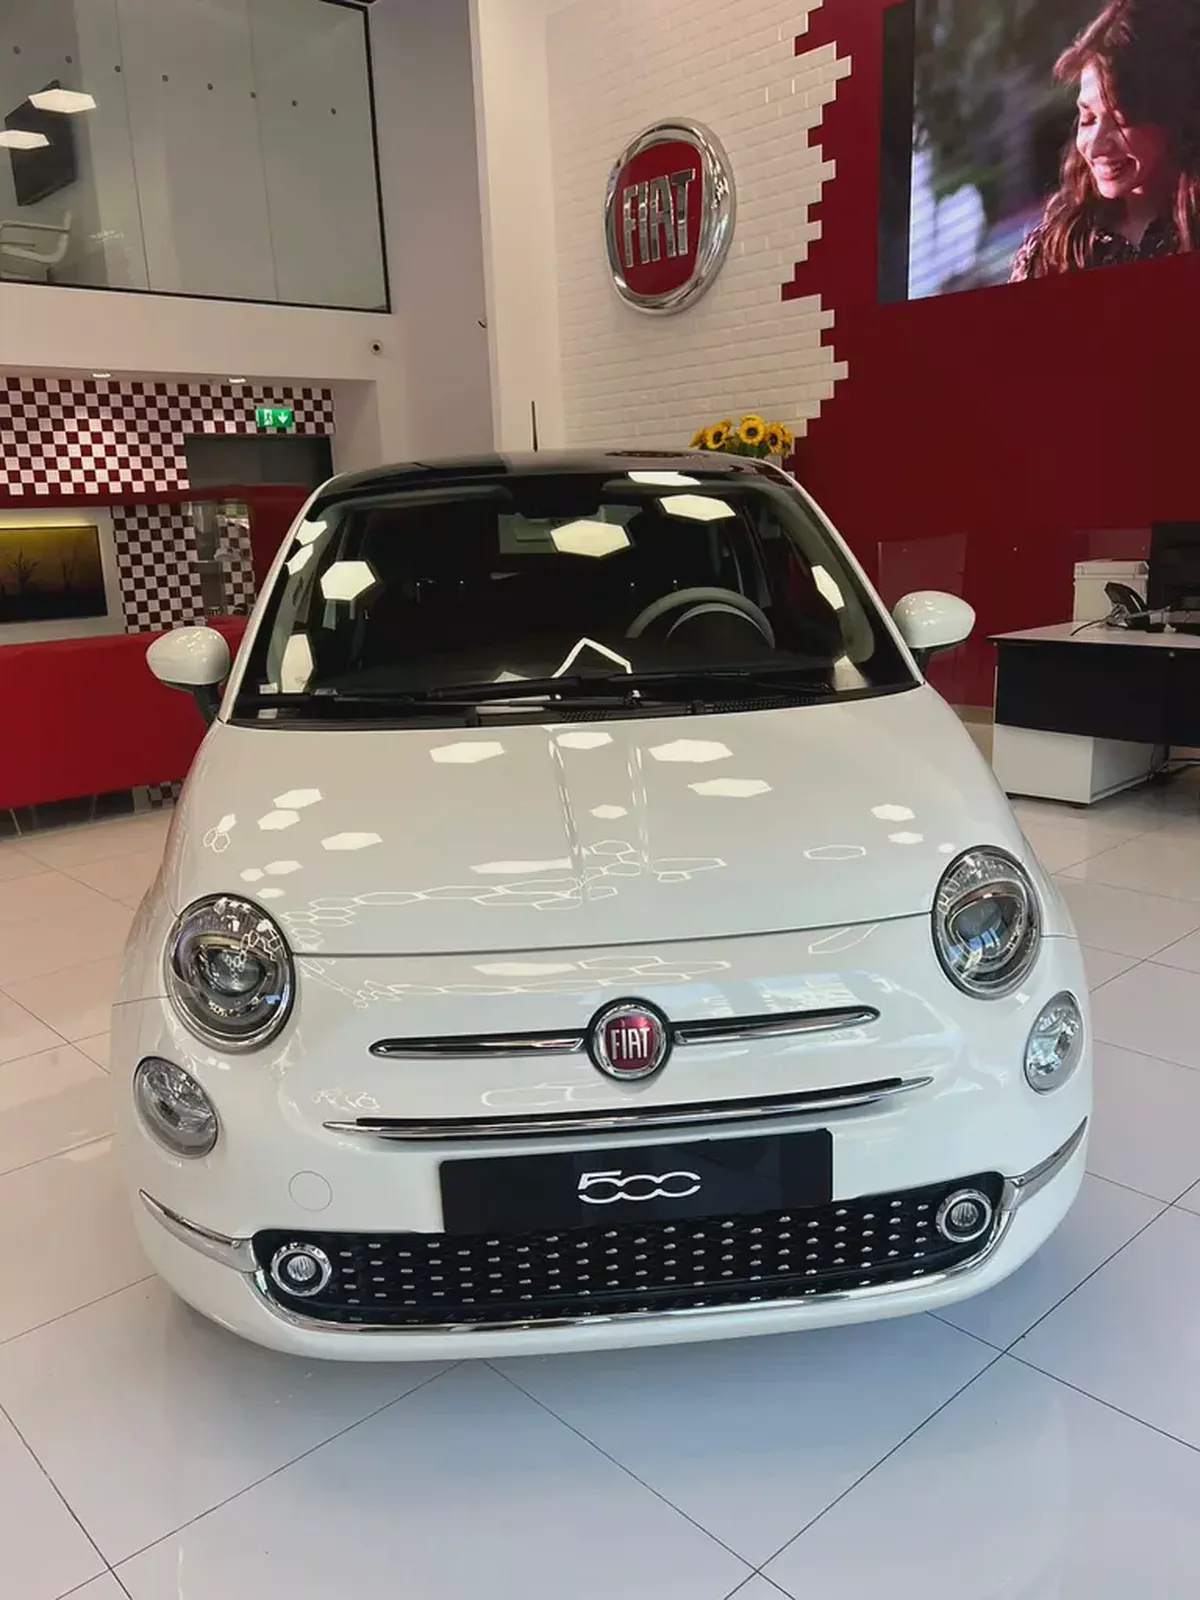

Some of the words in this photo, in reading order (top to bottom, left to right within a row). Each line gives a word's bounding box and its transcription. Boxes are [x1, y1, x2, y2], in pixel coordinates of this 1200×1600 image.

[623, 168, 696, 268] FIAT
[610, 1027, 651, 1060] FIAT
[577, 1170, 701, 1204] 500
